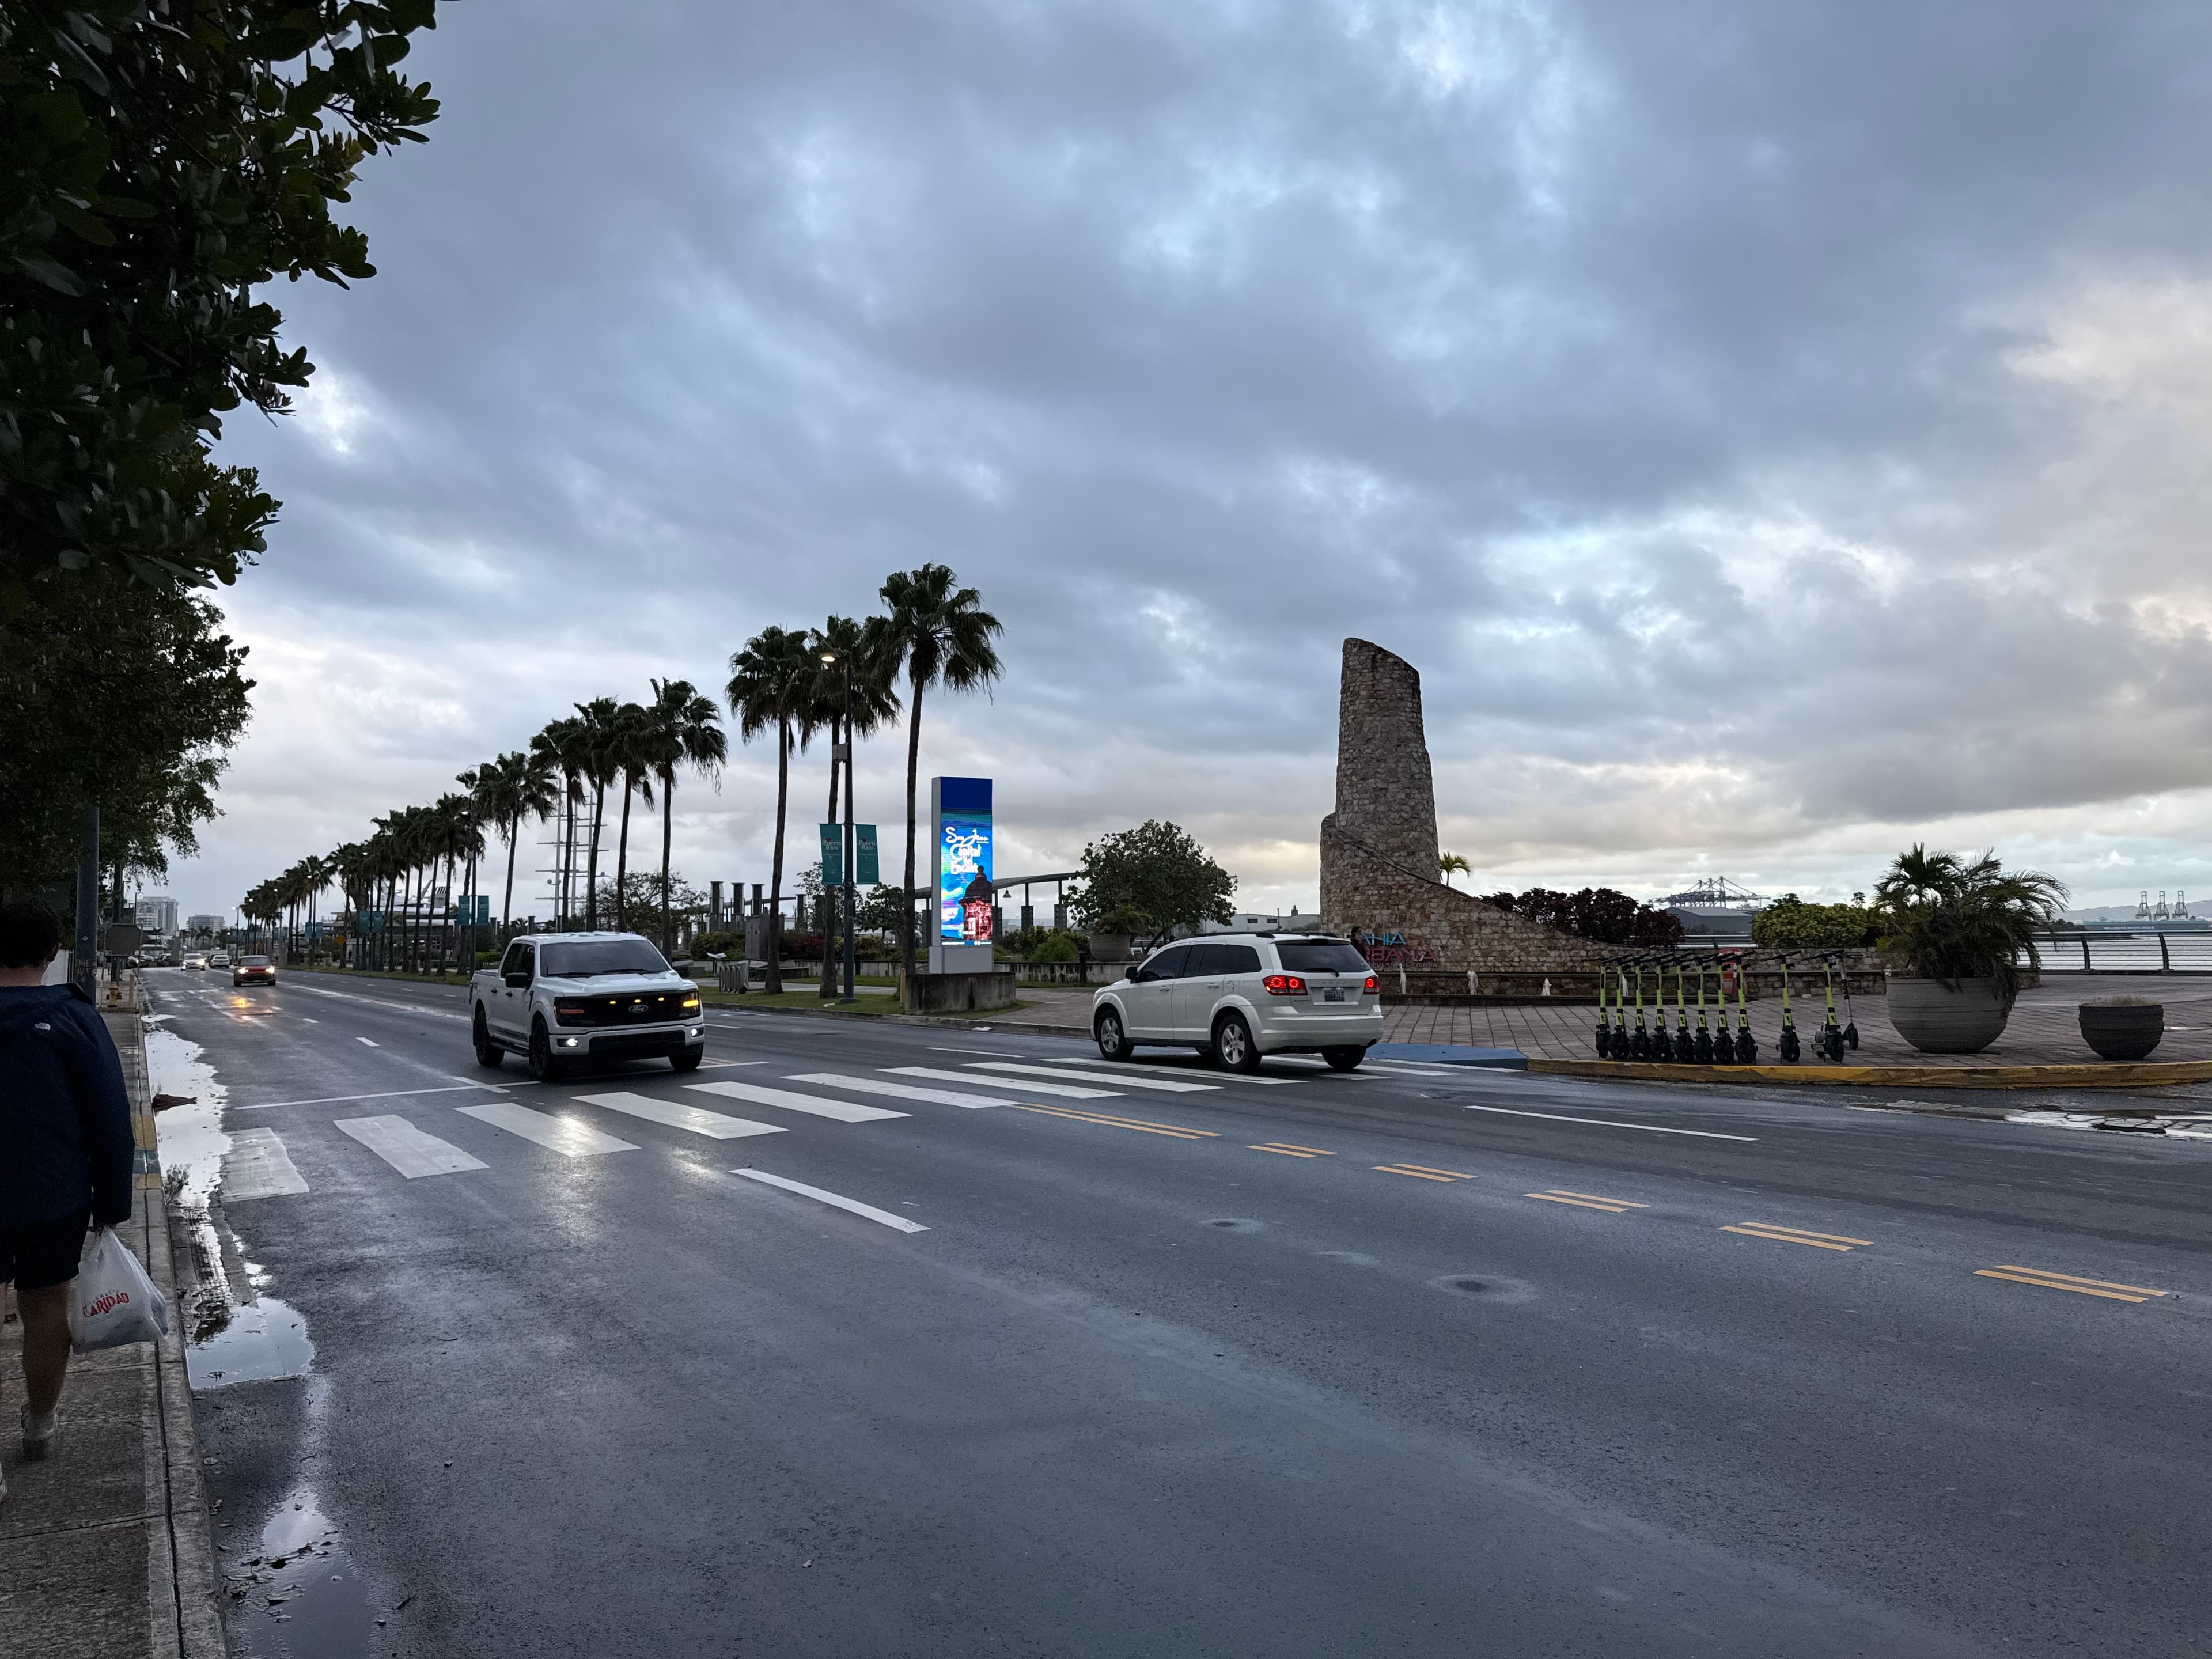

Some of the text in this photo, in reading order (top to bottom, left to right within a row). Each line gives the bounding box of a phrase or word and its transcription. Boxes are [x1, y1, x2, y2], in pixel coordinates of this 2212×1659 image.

[950, 843, 981, 861] Capital
[950, 861, 979, 875] Encant
[82, 1293, 129, 1317] CARIDAD
